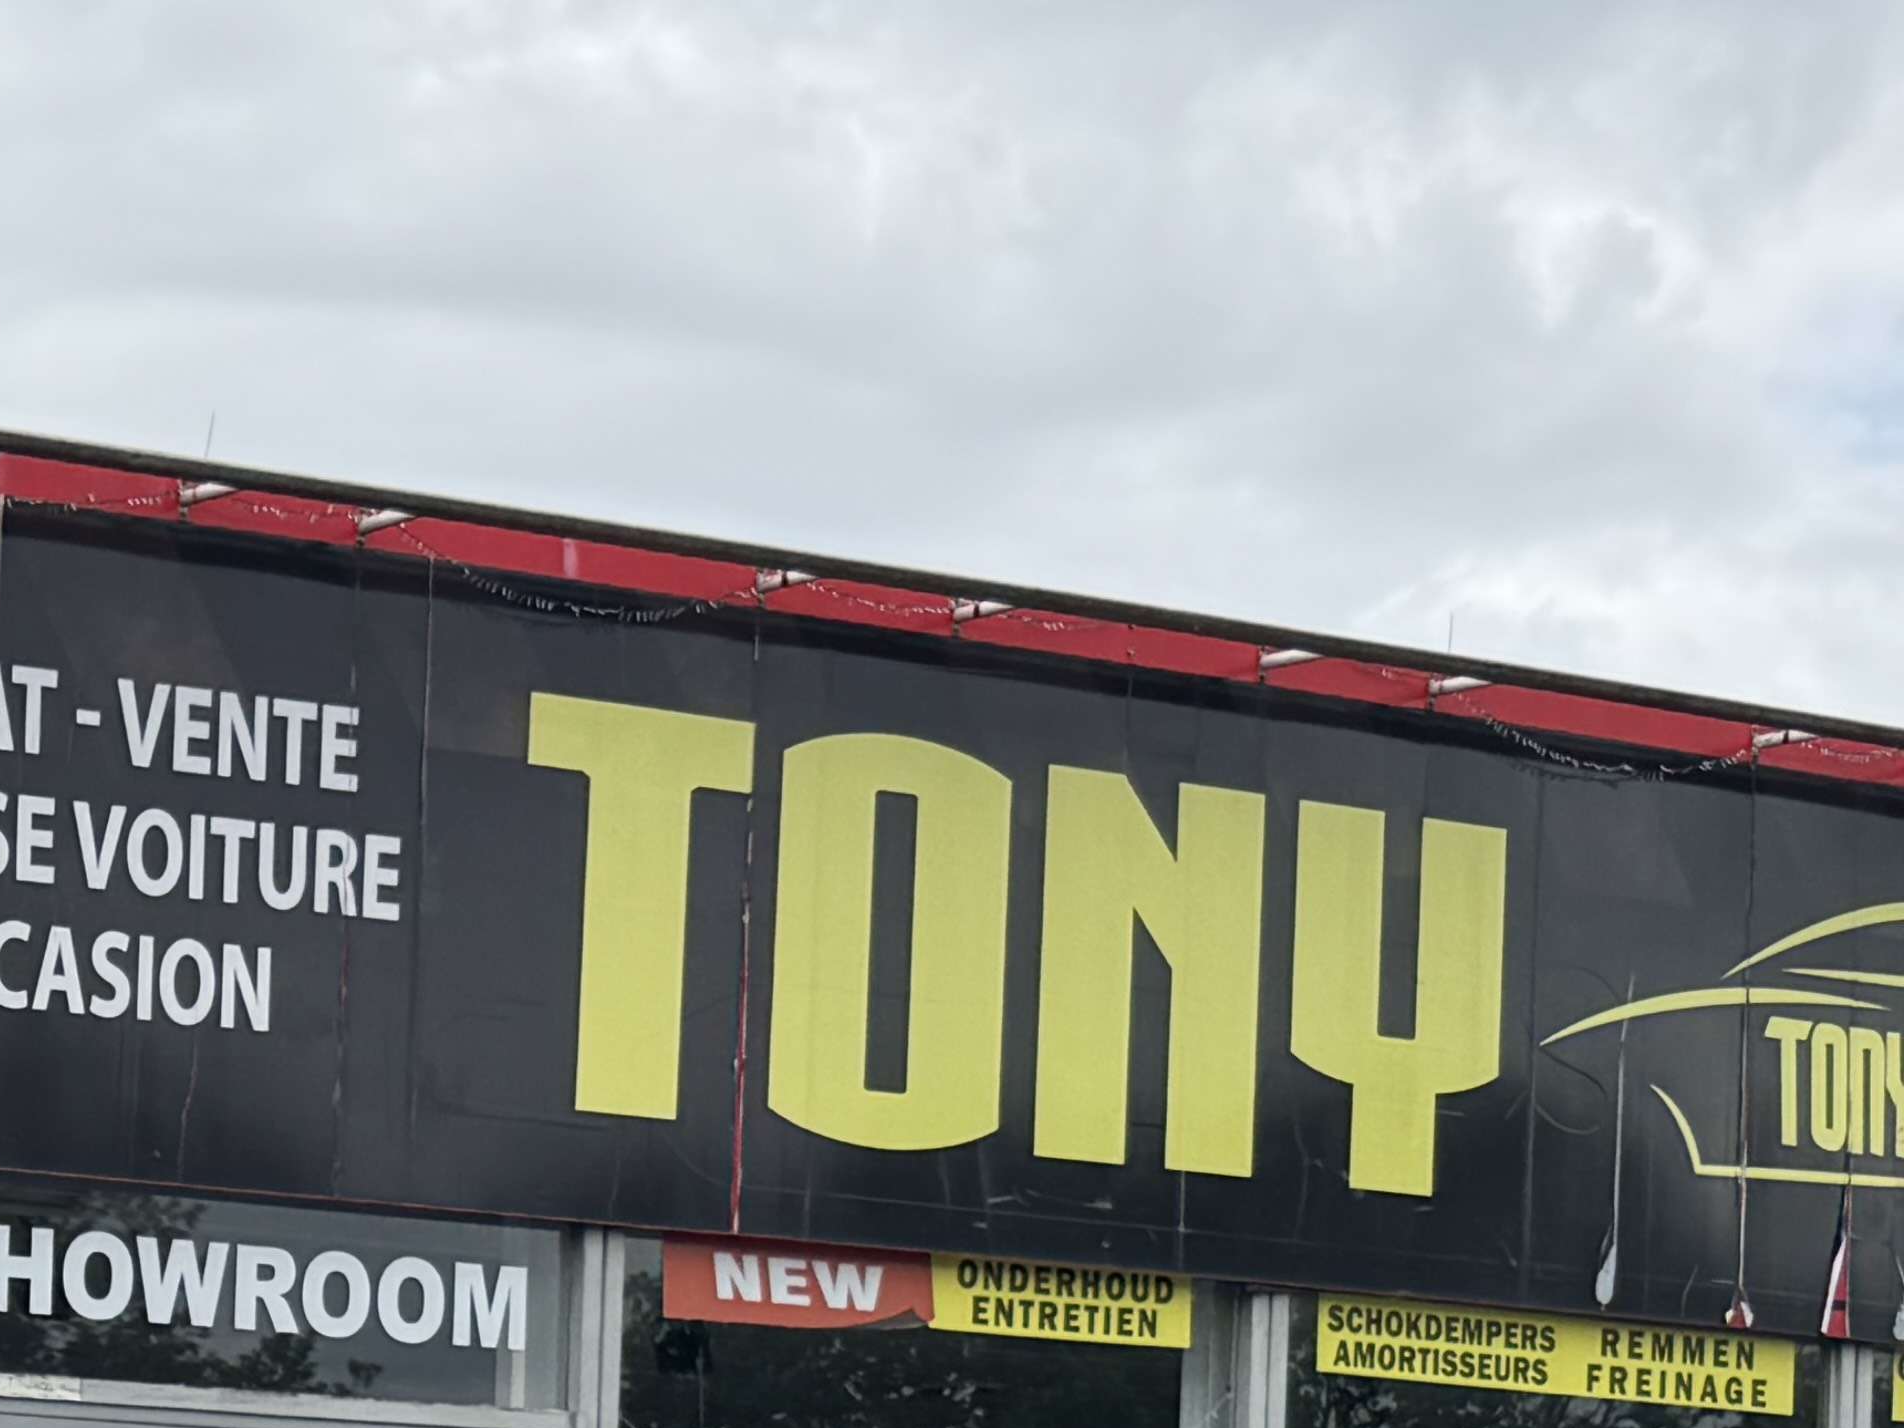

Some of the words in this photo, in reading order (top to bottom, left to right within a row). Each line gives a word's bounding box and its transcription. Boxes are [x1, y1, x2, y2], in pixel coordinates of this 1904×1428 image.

[117, 676, 361, 793] VENTE
[72, 799, 402, 923] VOITURE
[527, 690, 1508, 1197] TONY
[712, 1250, 884, 1313] NEW
[956, 1257, 1174, 1305] ONDERHOUD
[970, 1294, 1158, 1339] ENTRETIEN
[1326, 1303, 1557, 1353] SCHOKDEMPERS
[1333, 1338, 1549, 1386] AMORTISSEURS
[1600, 1327, 1756, 1372] REMMEN
[1586, 1362, 1768, 1409] FREINAGE
